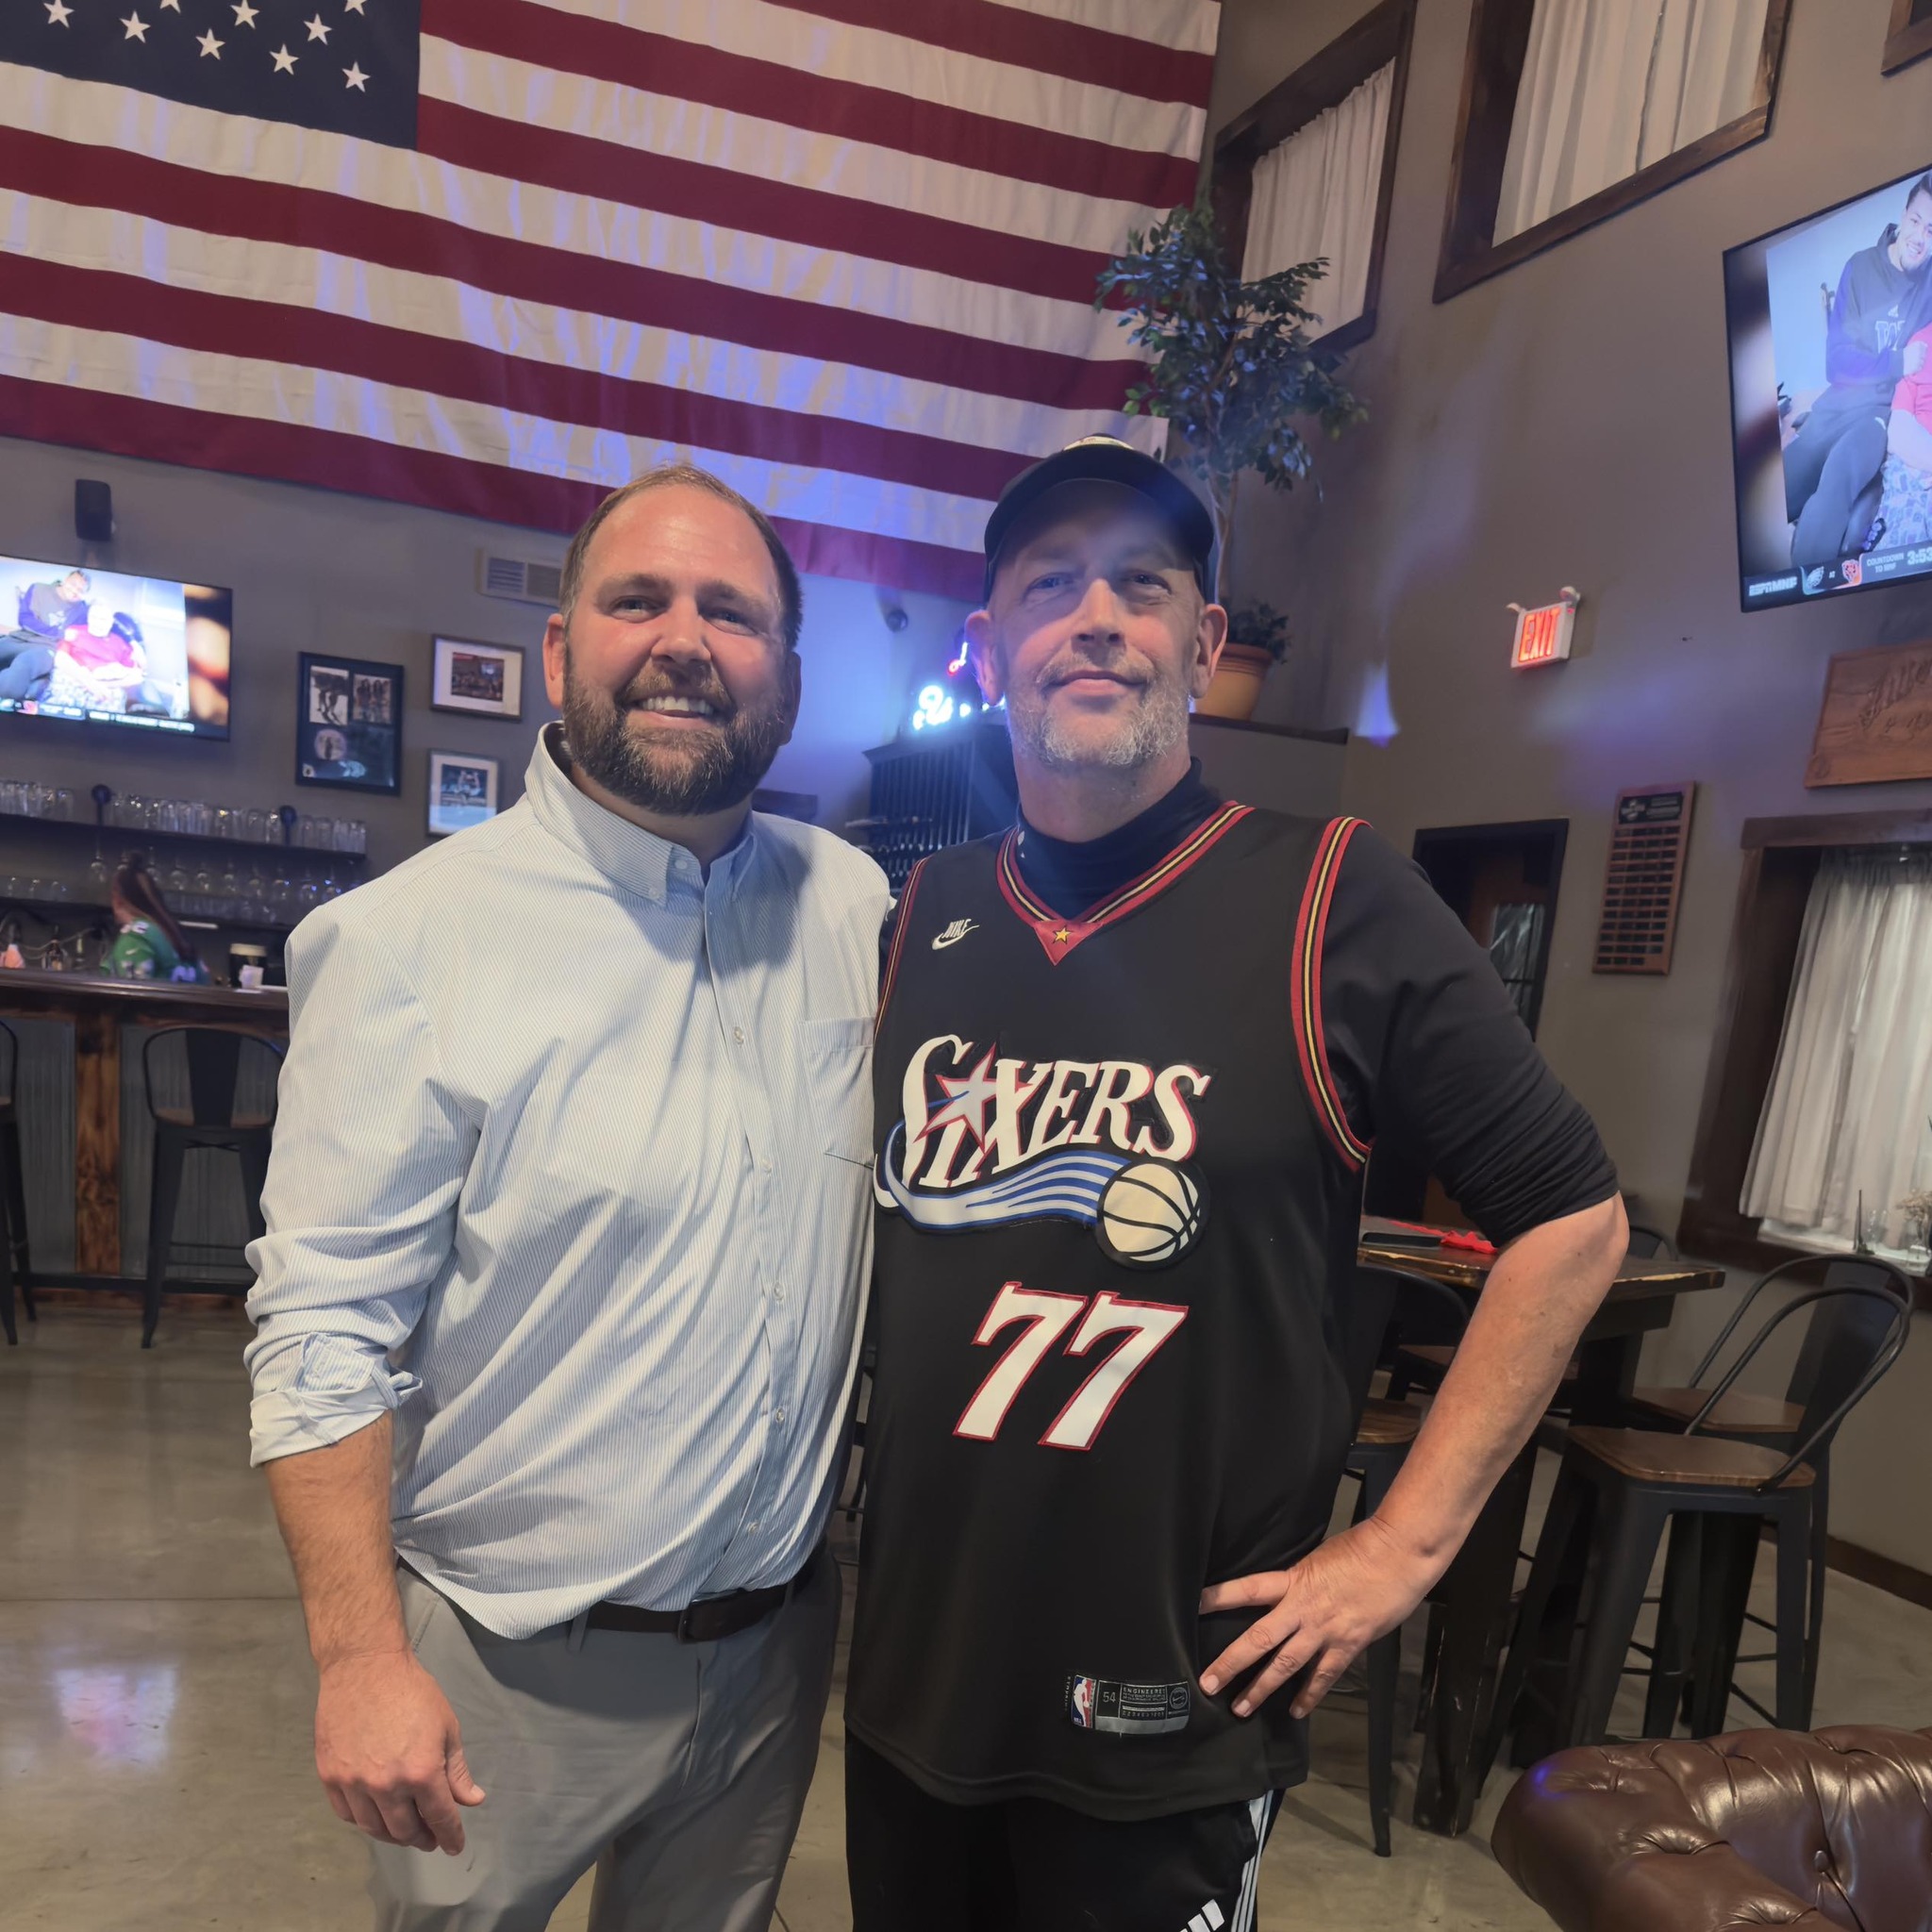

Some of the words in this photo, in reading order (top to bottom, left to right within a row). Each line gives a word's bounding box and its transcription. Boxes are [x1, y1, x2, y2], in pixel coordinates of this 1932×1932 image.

[1867, 552, 1905, 566] COUNTDOWN
[1518, 606, 1562, 662] EXIT
[941, 918, 972, 939] NIKE
[874, 1034, 1210, 1213] SIXERS
[952, 1281, 1189, 1450] 77
[1103, 1690, 1116, 1703] 54
